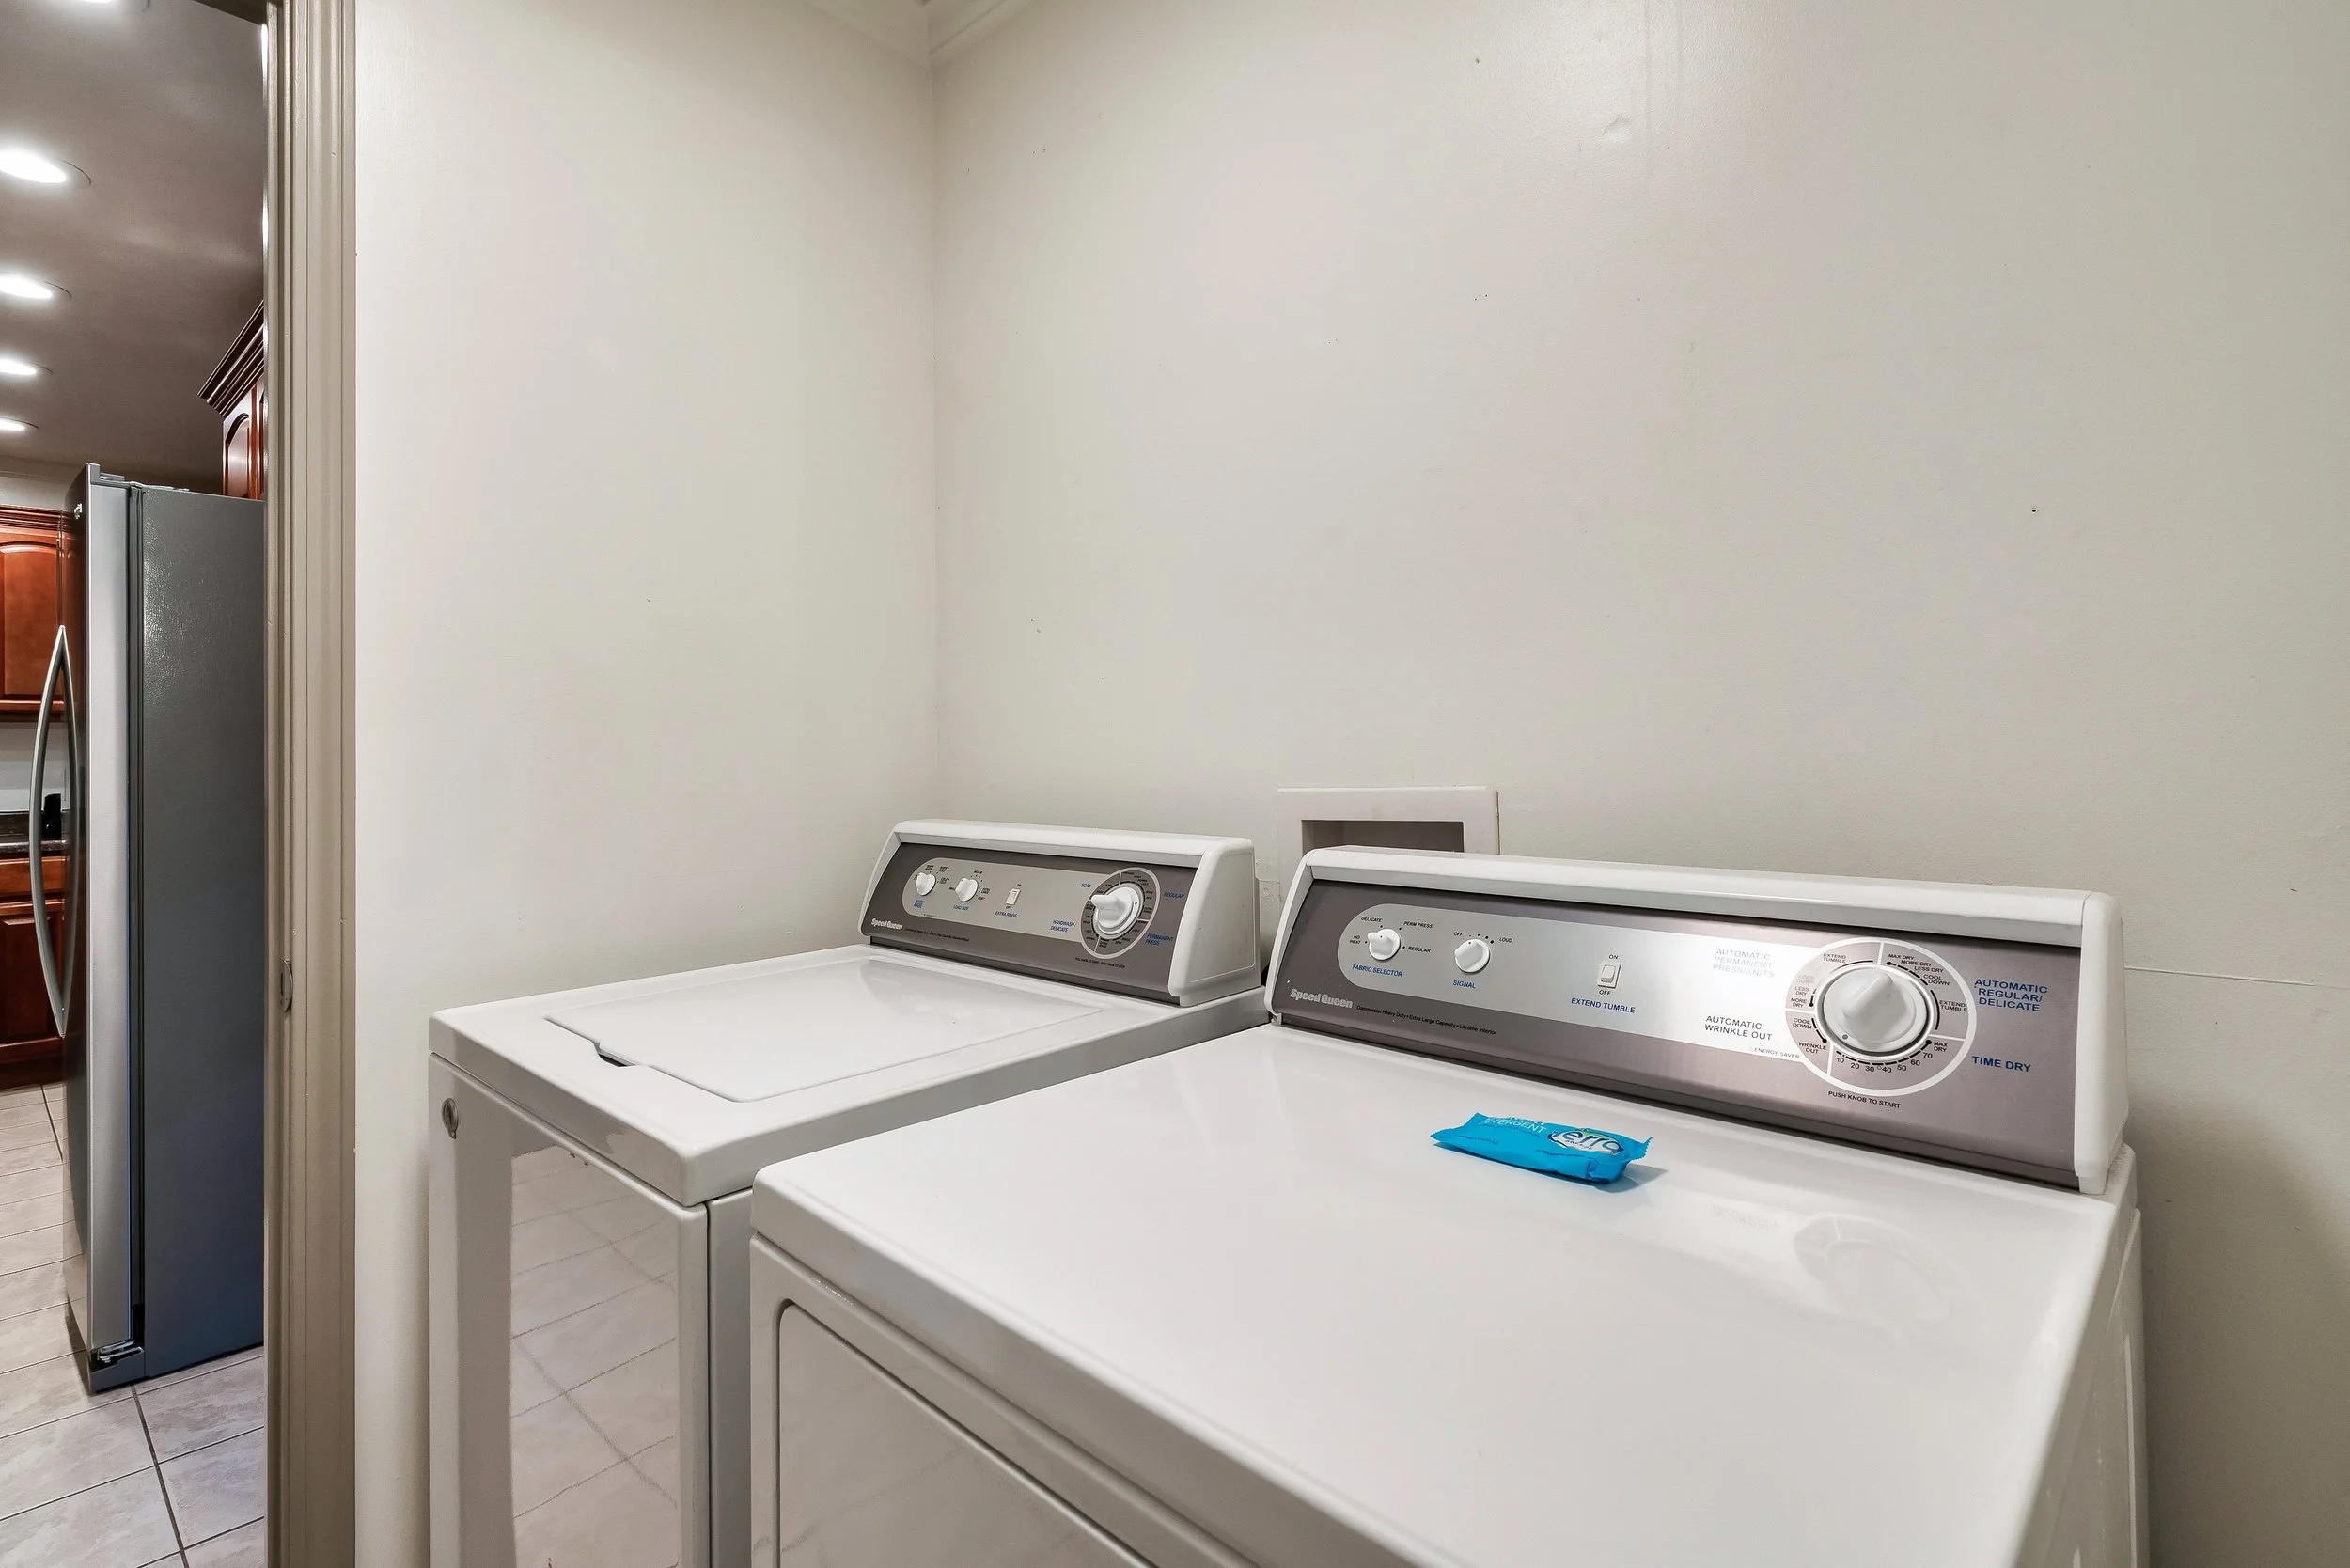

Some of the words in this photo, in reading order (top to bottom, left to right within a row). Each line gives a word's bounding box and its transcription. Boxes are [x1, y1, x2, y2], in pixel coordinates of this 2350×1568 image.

[870, 917, 887, 927] Speed
[886, 920, 903, 930] Queen
[1716, 949, 1771, 960] AUTOMATIC
[1714, 956, 1772, 969] PERMANENT
[1353, 964, 1372, 973] FABRIC
[1372, 968, 1402, 977] SELECTOR
[1453, 980, 1476, 989] SIGNAL
[1974, 979, 2048, 994] AUTOMATIC
[1290, 988, 1322, 1001] Speed
[1321, 994, 1353, 1009] Queen
[1978, 988, 2044, 1002] REGULAR/
[1571, 997, 1602, 1009] EXTEND
[1603, 1002, 1636, 1013] TUMBLE
[1940, 1004, 1968, 1012] TUMBLE
[1979, 997, 2041, 1011] DELICATE
[1435, 1020, 1456, 1028] Capacity
[1705, 1015, 1762, 1030] AUTOMATIC
[1704, 1024, 1749, 1038] WRINKLE
[1751, 1031, 1773, 1041] OUT
[1754, 1047, 1778, 1056] ENERGY
[1798, 1042, 1827, 1050] WRINKLE
[1972, 1056, 2002, 1068] TIME
[2005, 1060, 2031, 1073] DRY
[1828, 1090, 1846, 1099] PUSH
[1847, 1094, 1867, 1103] KNOB
[1879, 1101, 1901, 1109] START
[1483, 1118, 1547, 1134] TERGENT
